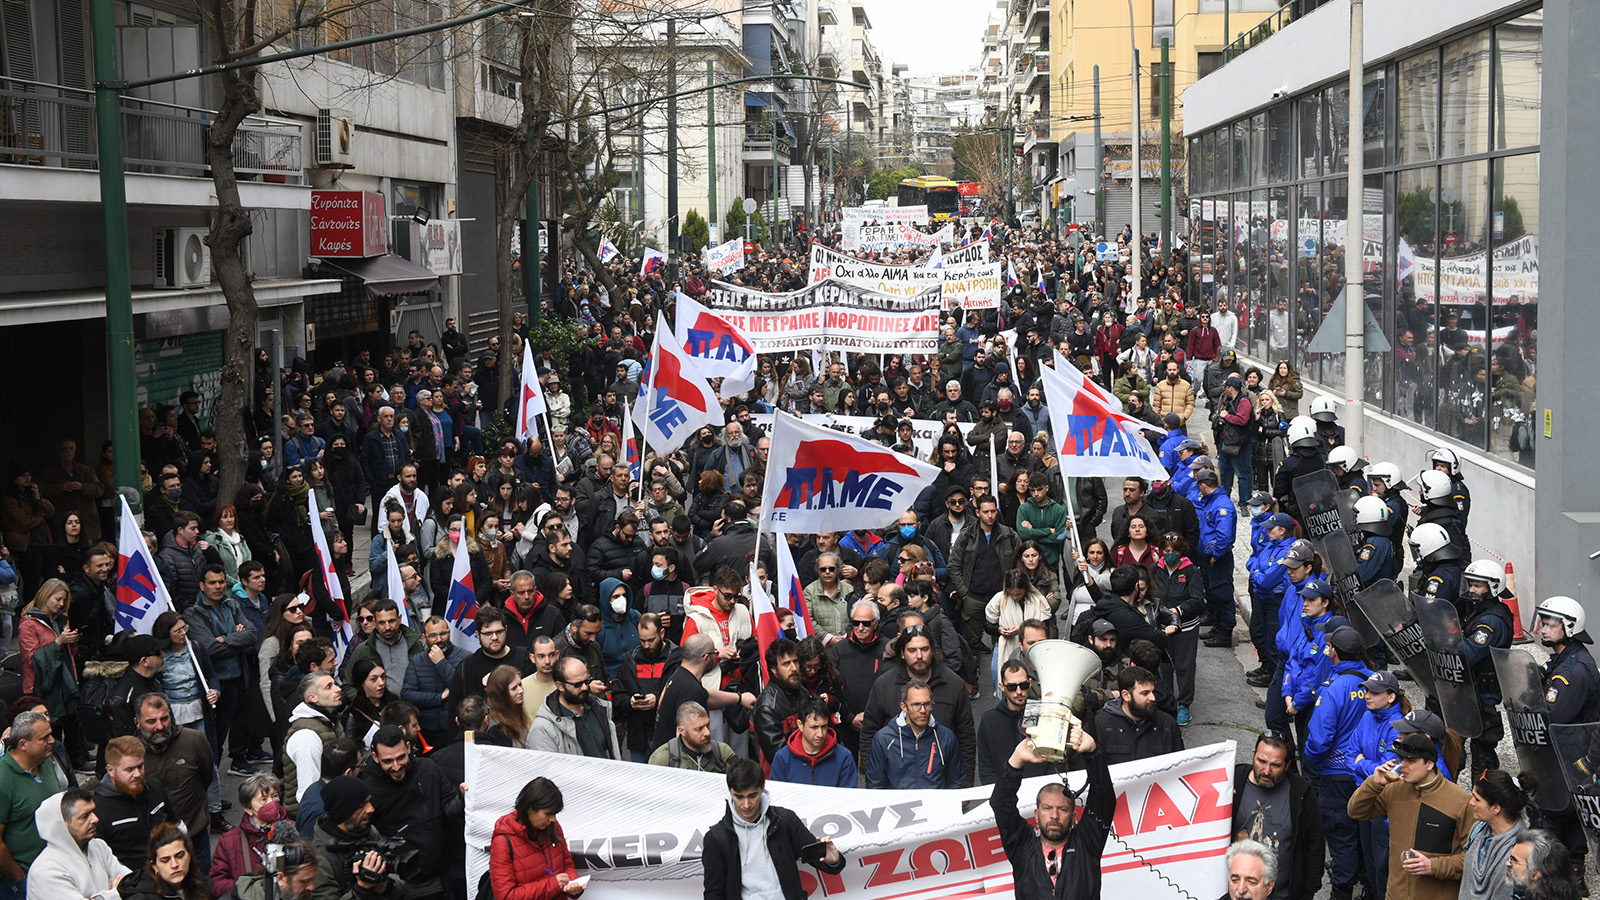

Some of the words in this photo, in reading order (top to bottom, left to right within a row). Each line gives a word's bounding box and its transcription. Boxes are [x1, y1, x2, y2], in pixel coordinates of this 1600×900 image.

[311, 195, 358, 211] Τυρόπιτα
[319, 237, 352, 254] Καφές
[815, 248, 824, 264] ΟΙ
[881, 268, 909, 281] ΑΙΜΑ
[927, 271, 938, 279] τα
[977, 268, 994, 278] τους
[944, 278, 998, 294] ΑΝΑΤΡΟΠΗ
[747, 290, 812, 310] ΜΕΤΡΑΤΕ
[814, 286, 858, 306] ΚΕΡΔΗ
[861, 294, 889, 310] ΚΑΙ
[720, 314, 746, 332] ΕΙΣ
[749, 312, 820, 333] ΜΕΤΡΑΜΕ
[912, 314, 941, 332] ΖΩΕ
[760, 336, 822, 349] ΣΩΜΑΤΕΙΟ
[824, 336, 939, 349] ΡΗΜΑΤΟΠΙΣΤΩΤΙΚΟ
[785, 466, 904, 511] Π.Α.ΜΕ
[1305, 508, 1341, 529] ΑΣΤΥΝΟΜΙ
[1350, 689, 1367, 701] PO
[1580, 808, 1600, 830] PO
[570, 832, 705, 870] ΚΕΡΔ
[802, 800, 929, 840] ΟΥΣ
[859, 827, 1006, 891] ΖΩΕ
